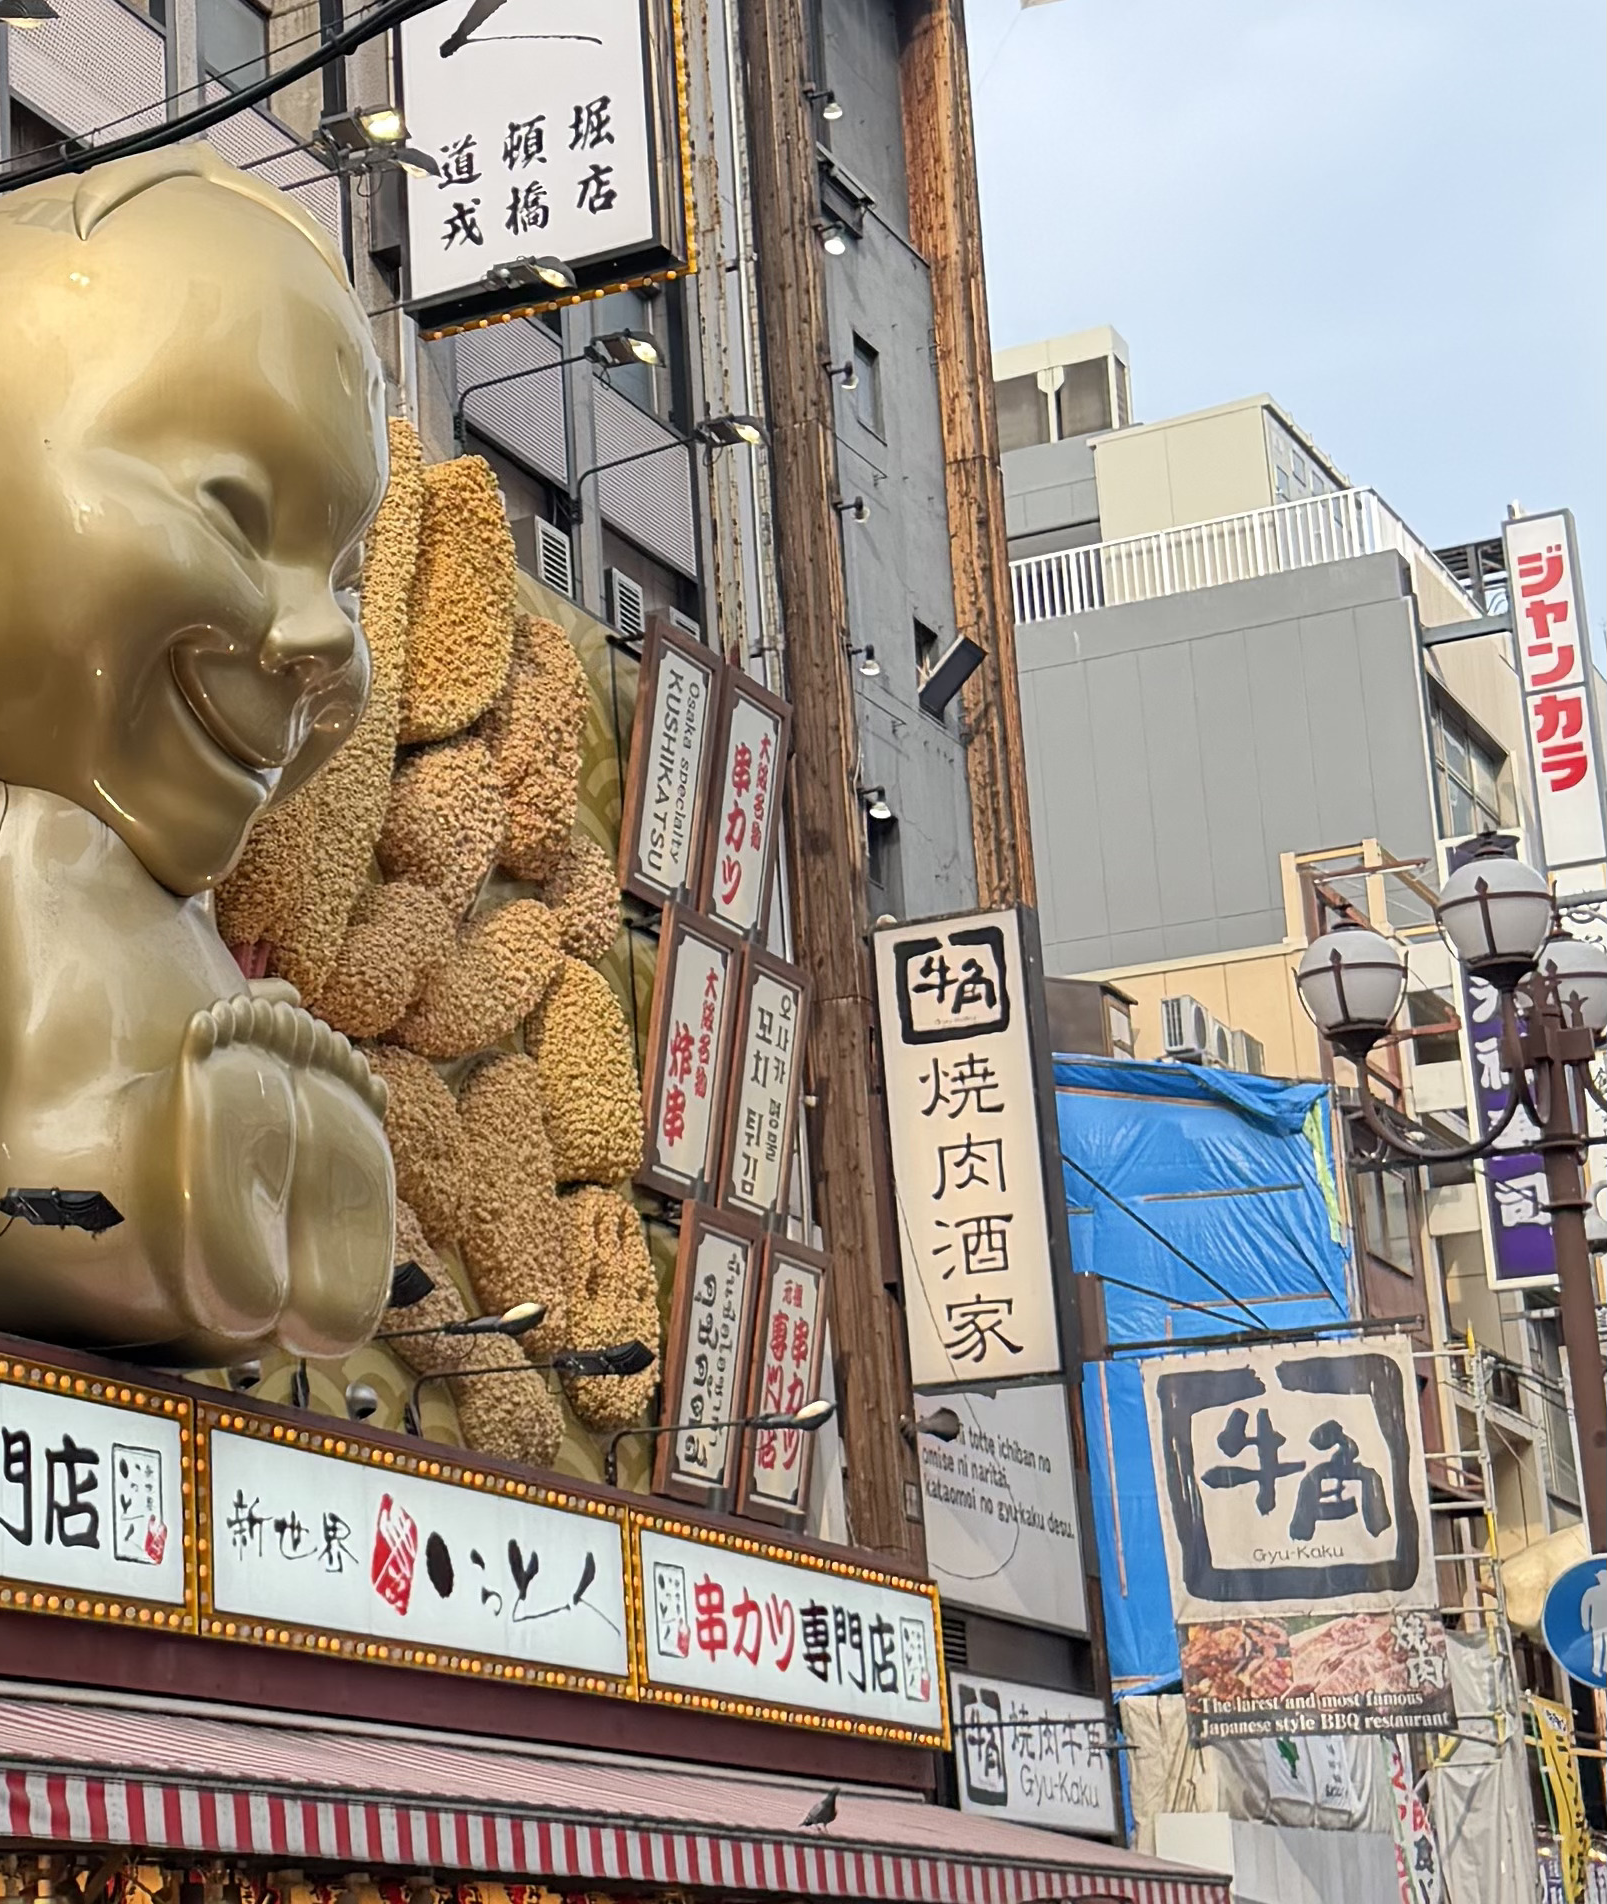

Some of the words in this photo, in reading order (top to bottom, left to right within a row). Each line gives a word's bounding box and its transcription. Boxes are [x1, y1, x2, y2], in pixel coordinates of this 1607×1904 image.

[438, 94, 617, 189] 道頓堀
[440, 162, 620, 254] 戎橋店
[1517, 542, 1590, 793] ジャンカラ
[681, 681, 701, 751] Osaka
[647, 669, 685, 872] KUSHIKATSU
[669, 757, 690, 865] specialty
[750, 732, 772, 852] 大阪名物
[721, 741, 753, 905] 串カツ
[912, 955, 997, 1014] 牛角
[694, 967, 719, 1099] 大阪名物
[773, 994, 792, 1085] 오사카
[662, 1019, 695, 1147] 炸串
[741, 1107, 765, 1196] 튀김
[918, 1052, 1025, 1364] 焼肉酒家
[1200, 1407, 1392, 1541] 牛角
[226, 1487, 360, 1574] 新世界
[1252, 1545, 1345, 1567] Gyu-Kaku
[426, 1530, 622, 1638] いっとく
[694, 1573, 899, 1694] 串カツ専門店
[967, 1707, 1003, 1779] 牛角
[1197, 1696, 1232, 1715] The
[1320, 1692, 1361, 1709] most
[1365, 1691, 1424, 1707] famous
[1198, 1716, 1272, 1739] Japanese
[1274, 1714, 1316, 1734] style
[1321, 1713, 1360, 1731] BBQ
[1364, 1710, 1450, 1730] restaurant
[1020, 1764, 1100, 1809] Gyu-Kaku
